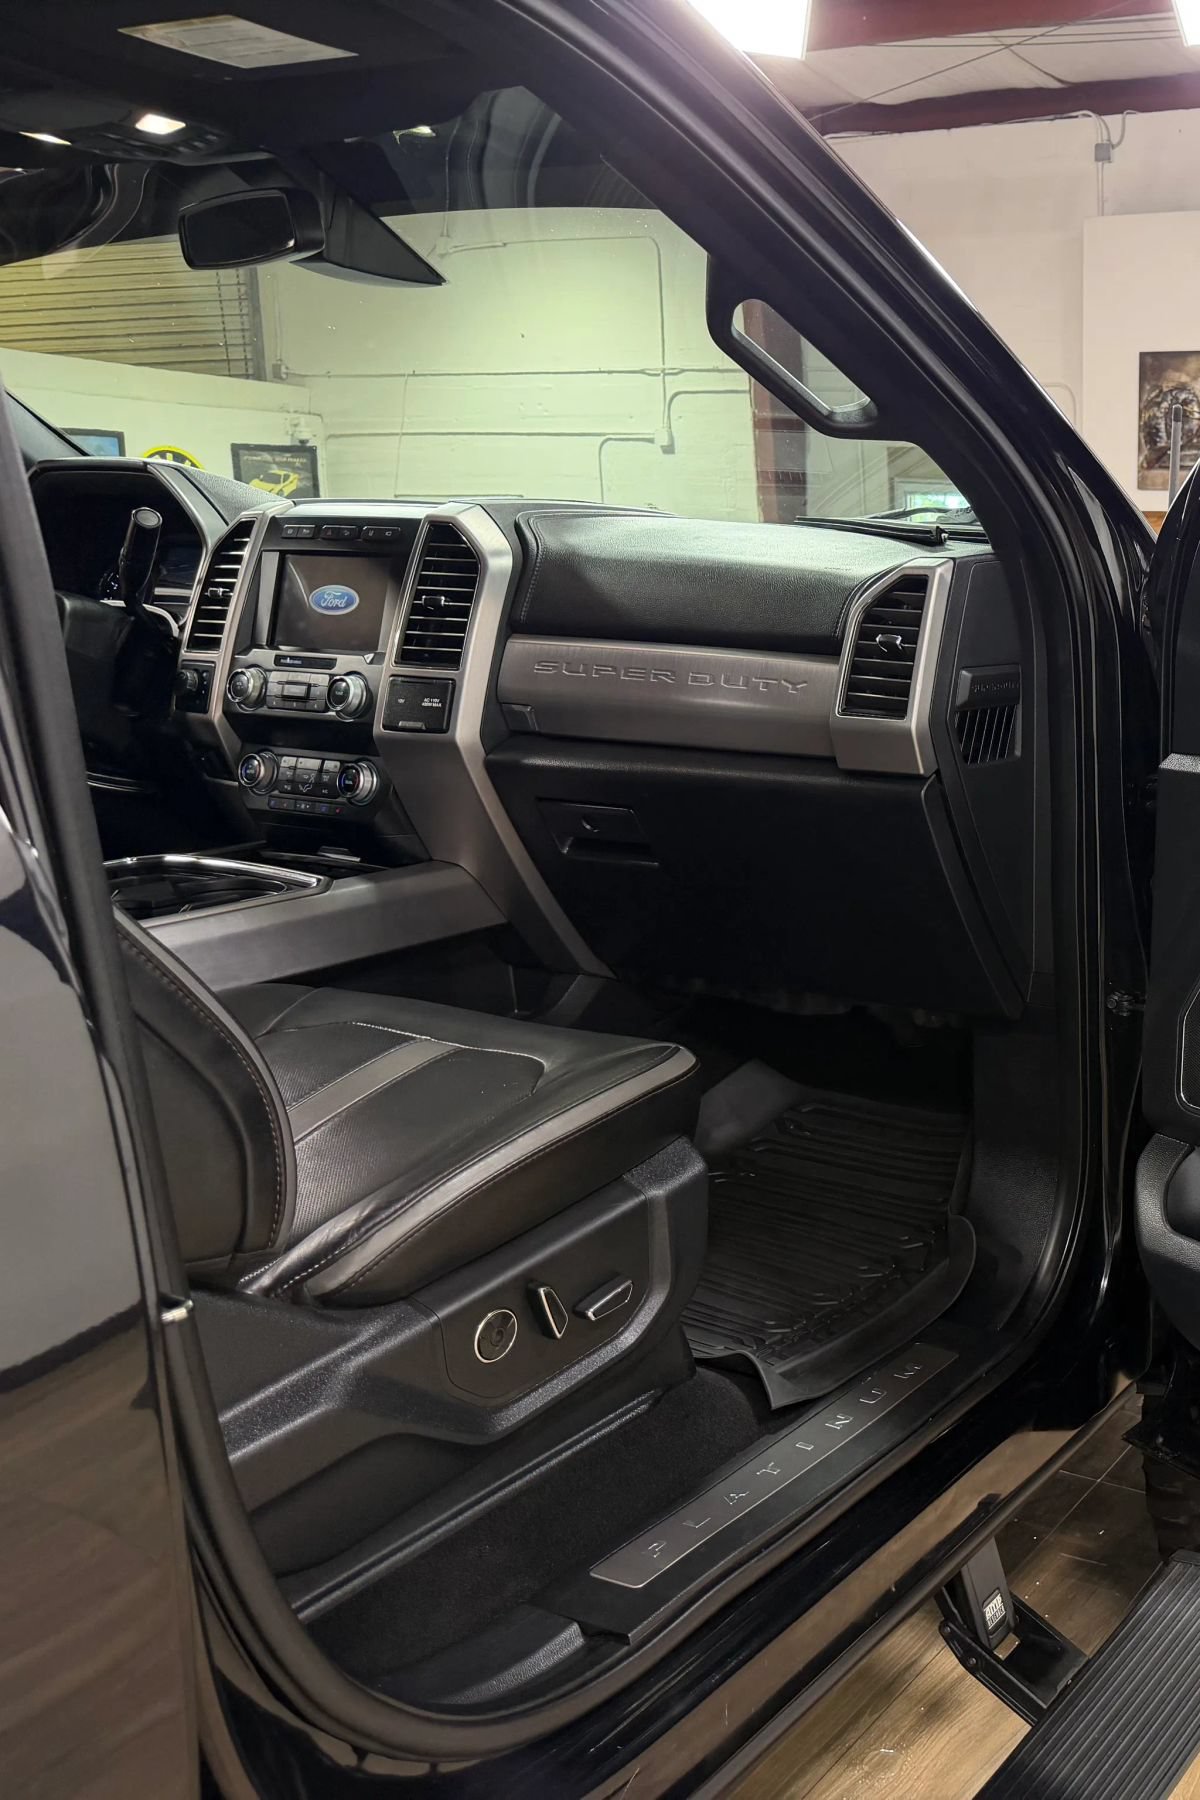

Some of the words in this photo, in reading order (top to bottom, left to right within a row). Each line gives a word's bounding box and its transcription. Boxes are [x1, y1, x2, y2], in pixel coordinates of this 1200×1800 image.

[320, 590, 348, 608] Ford
[534, 660, 676, 684] SUPER
[688, 671, 808, 694] DUTY
[643, 1363, 924, 1559] PLATINUM
